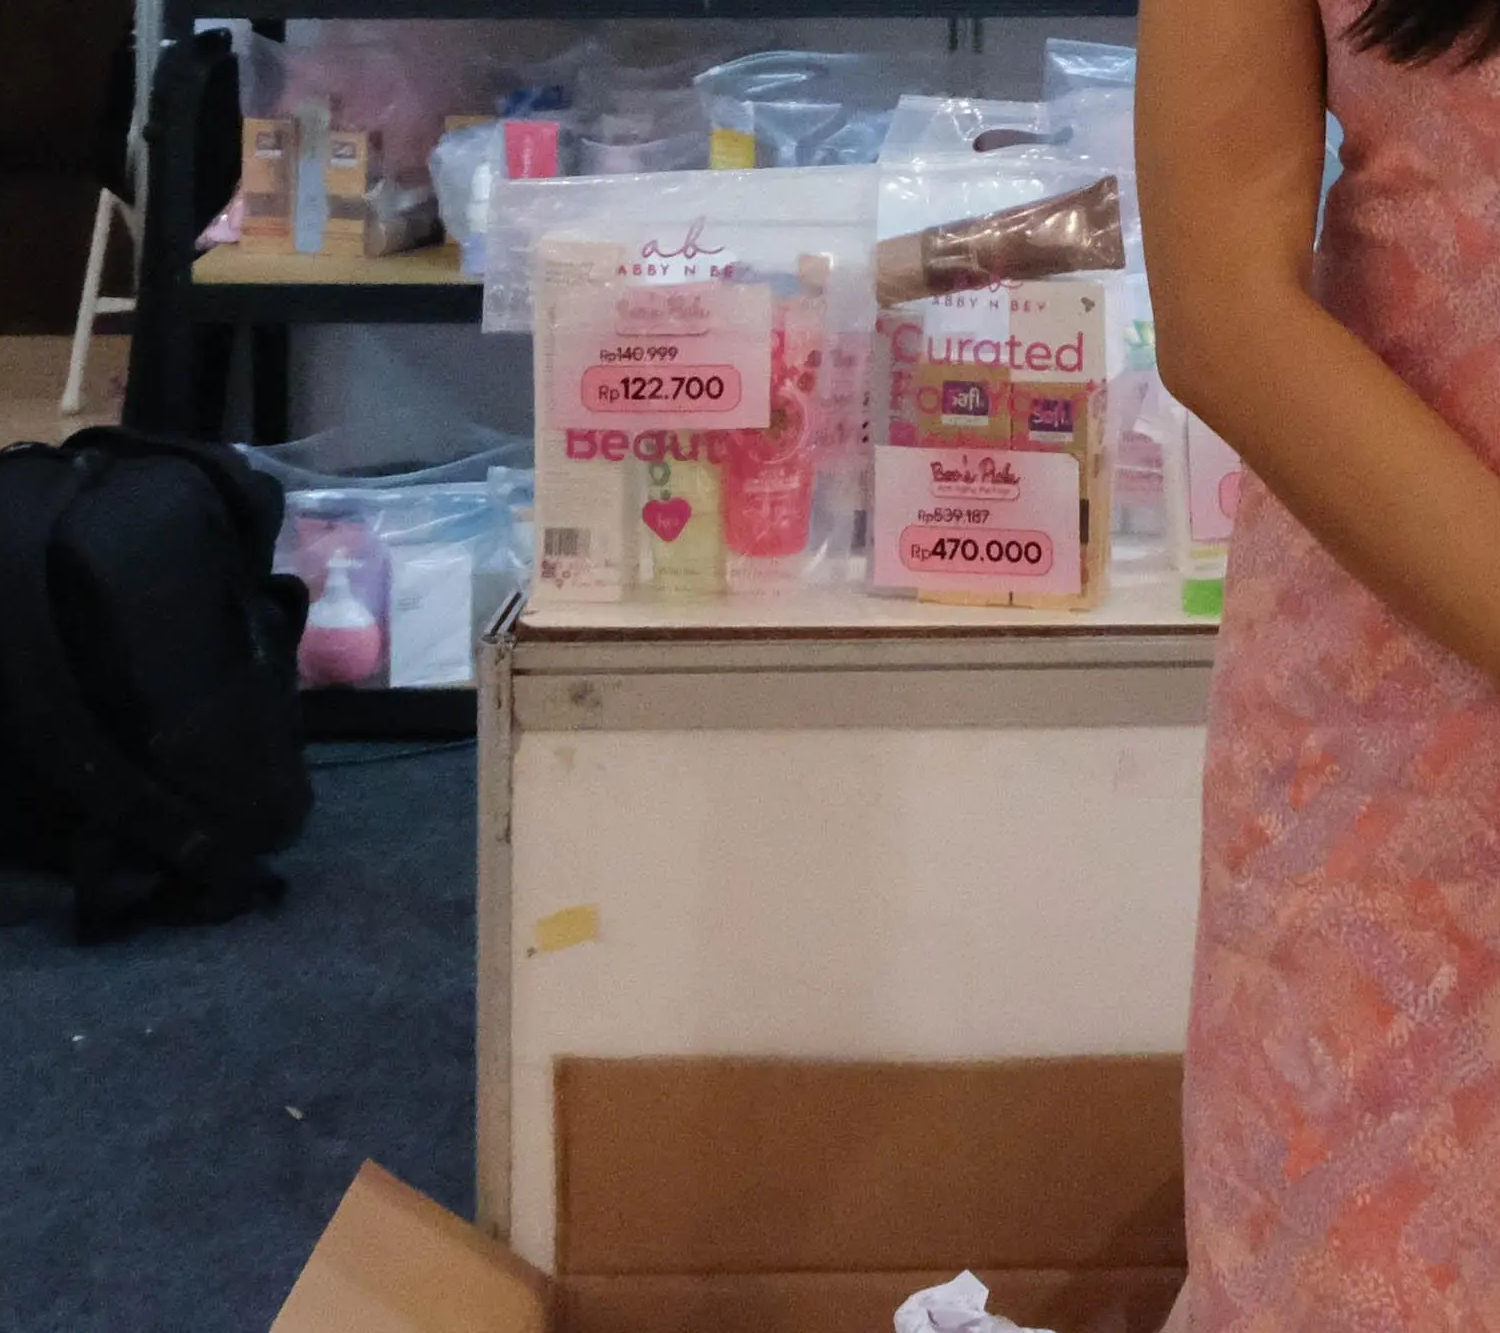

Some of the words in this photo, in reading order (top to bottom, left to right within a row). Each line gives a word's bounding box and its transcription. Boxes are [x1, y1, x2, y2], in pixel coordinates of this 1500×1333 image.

[617, 264, 670, 277] ABBY
[684, 264, 697, 277] N
[709, 264, 737, 279] BE
[931, 294, 978, 310] ABBY
[989, 299, 1000, 312] N
[598, 375, 725, 403] Rp122.700
[910, 537, 1043, 565] Rp470.000
